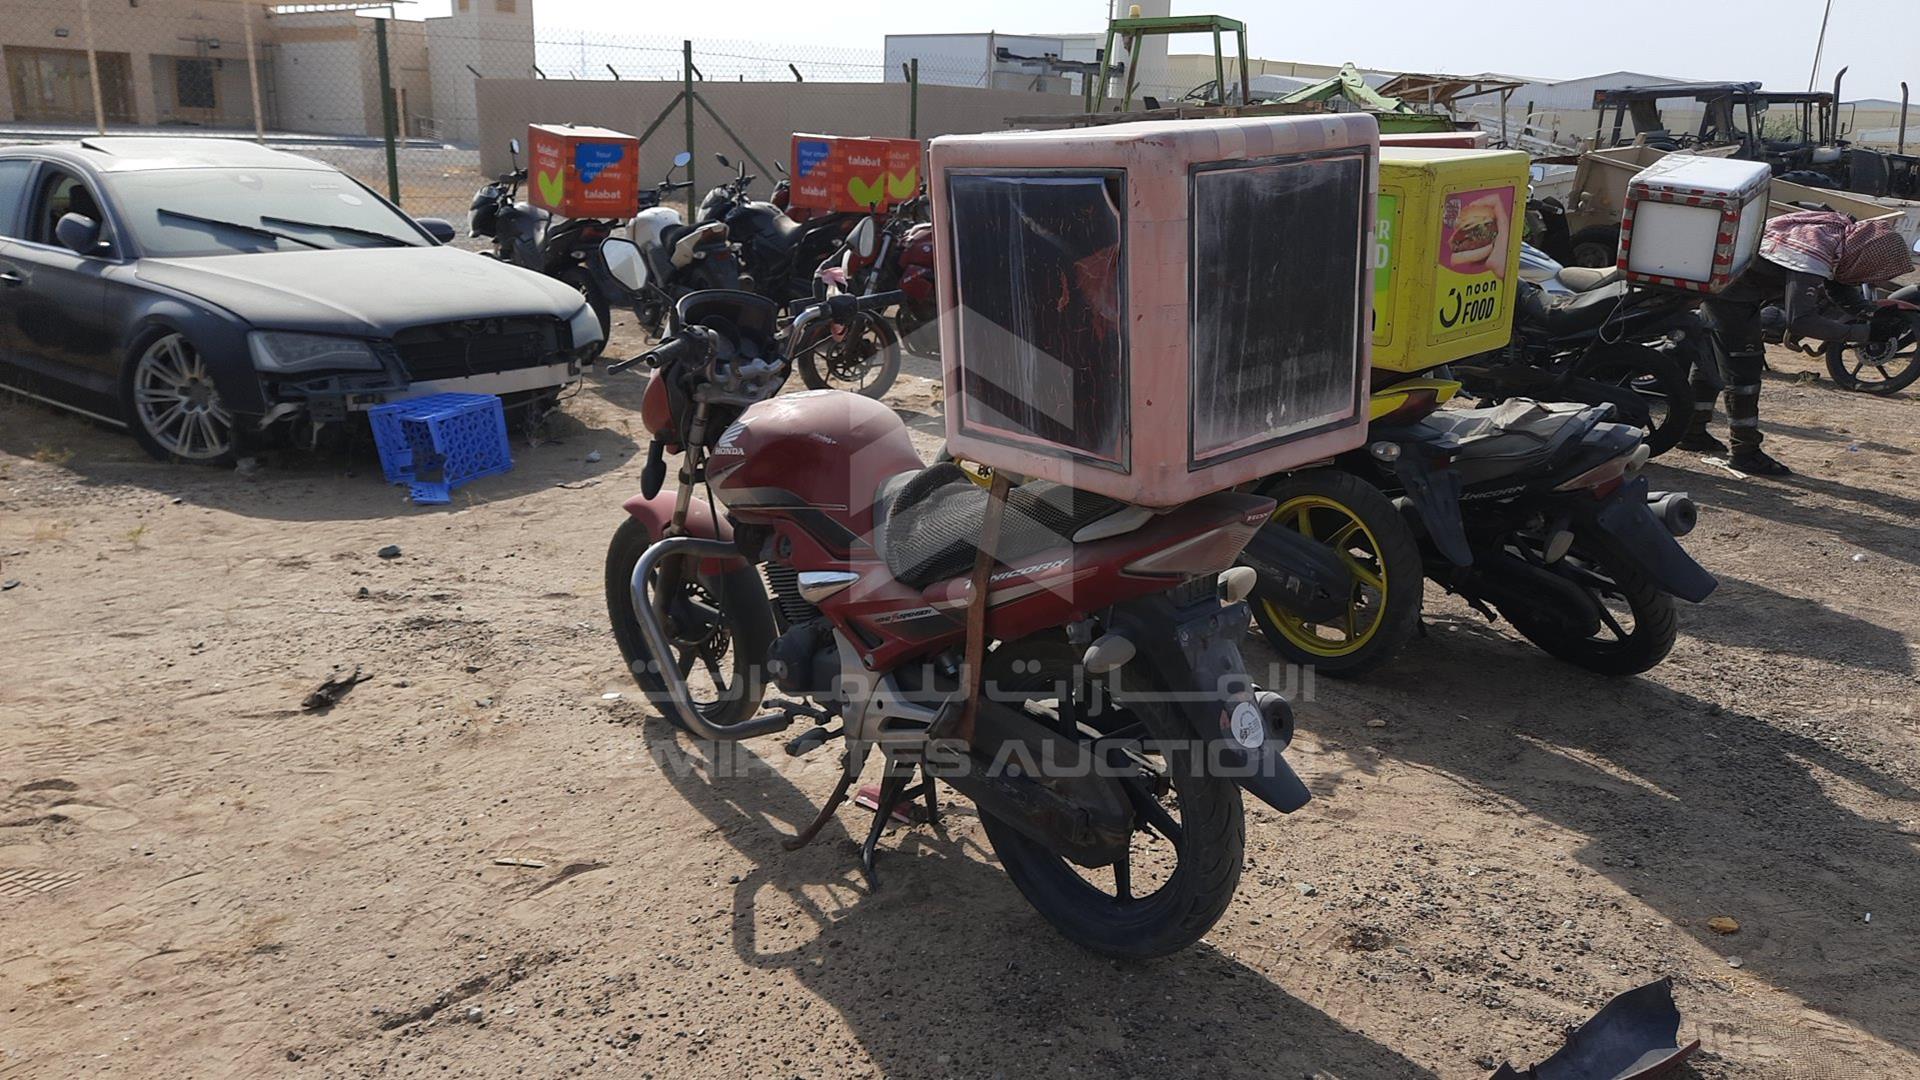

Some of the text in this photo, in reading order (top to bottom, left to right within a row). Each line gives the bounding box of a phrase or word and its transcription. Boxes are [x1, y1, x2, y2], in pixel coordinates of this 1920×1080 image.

[848, 156, 881, 168] talabat
[584, 188, 621, 200] talabat
[801, 186, 827, 198] talabat
[1466, 280, 1497, 296] noon
[1462, 297, 1495, 325] FOOD
[715, 447, 745, 456] HONDA
